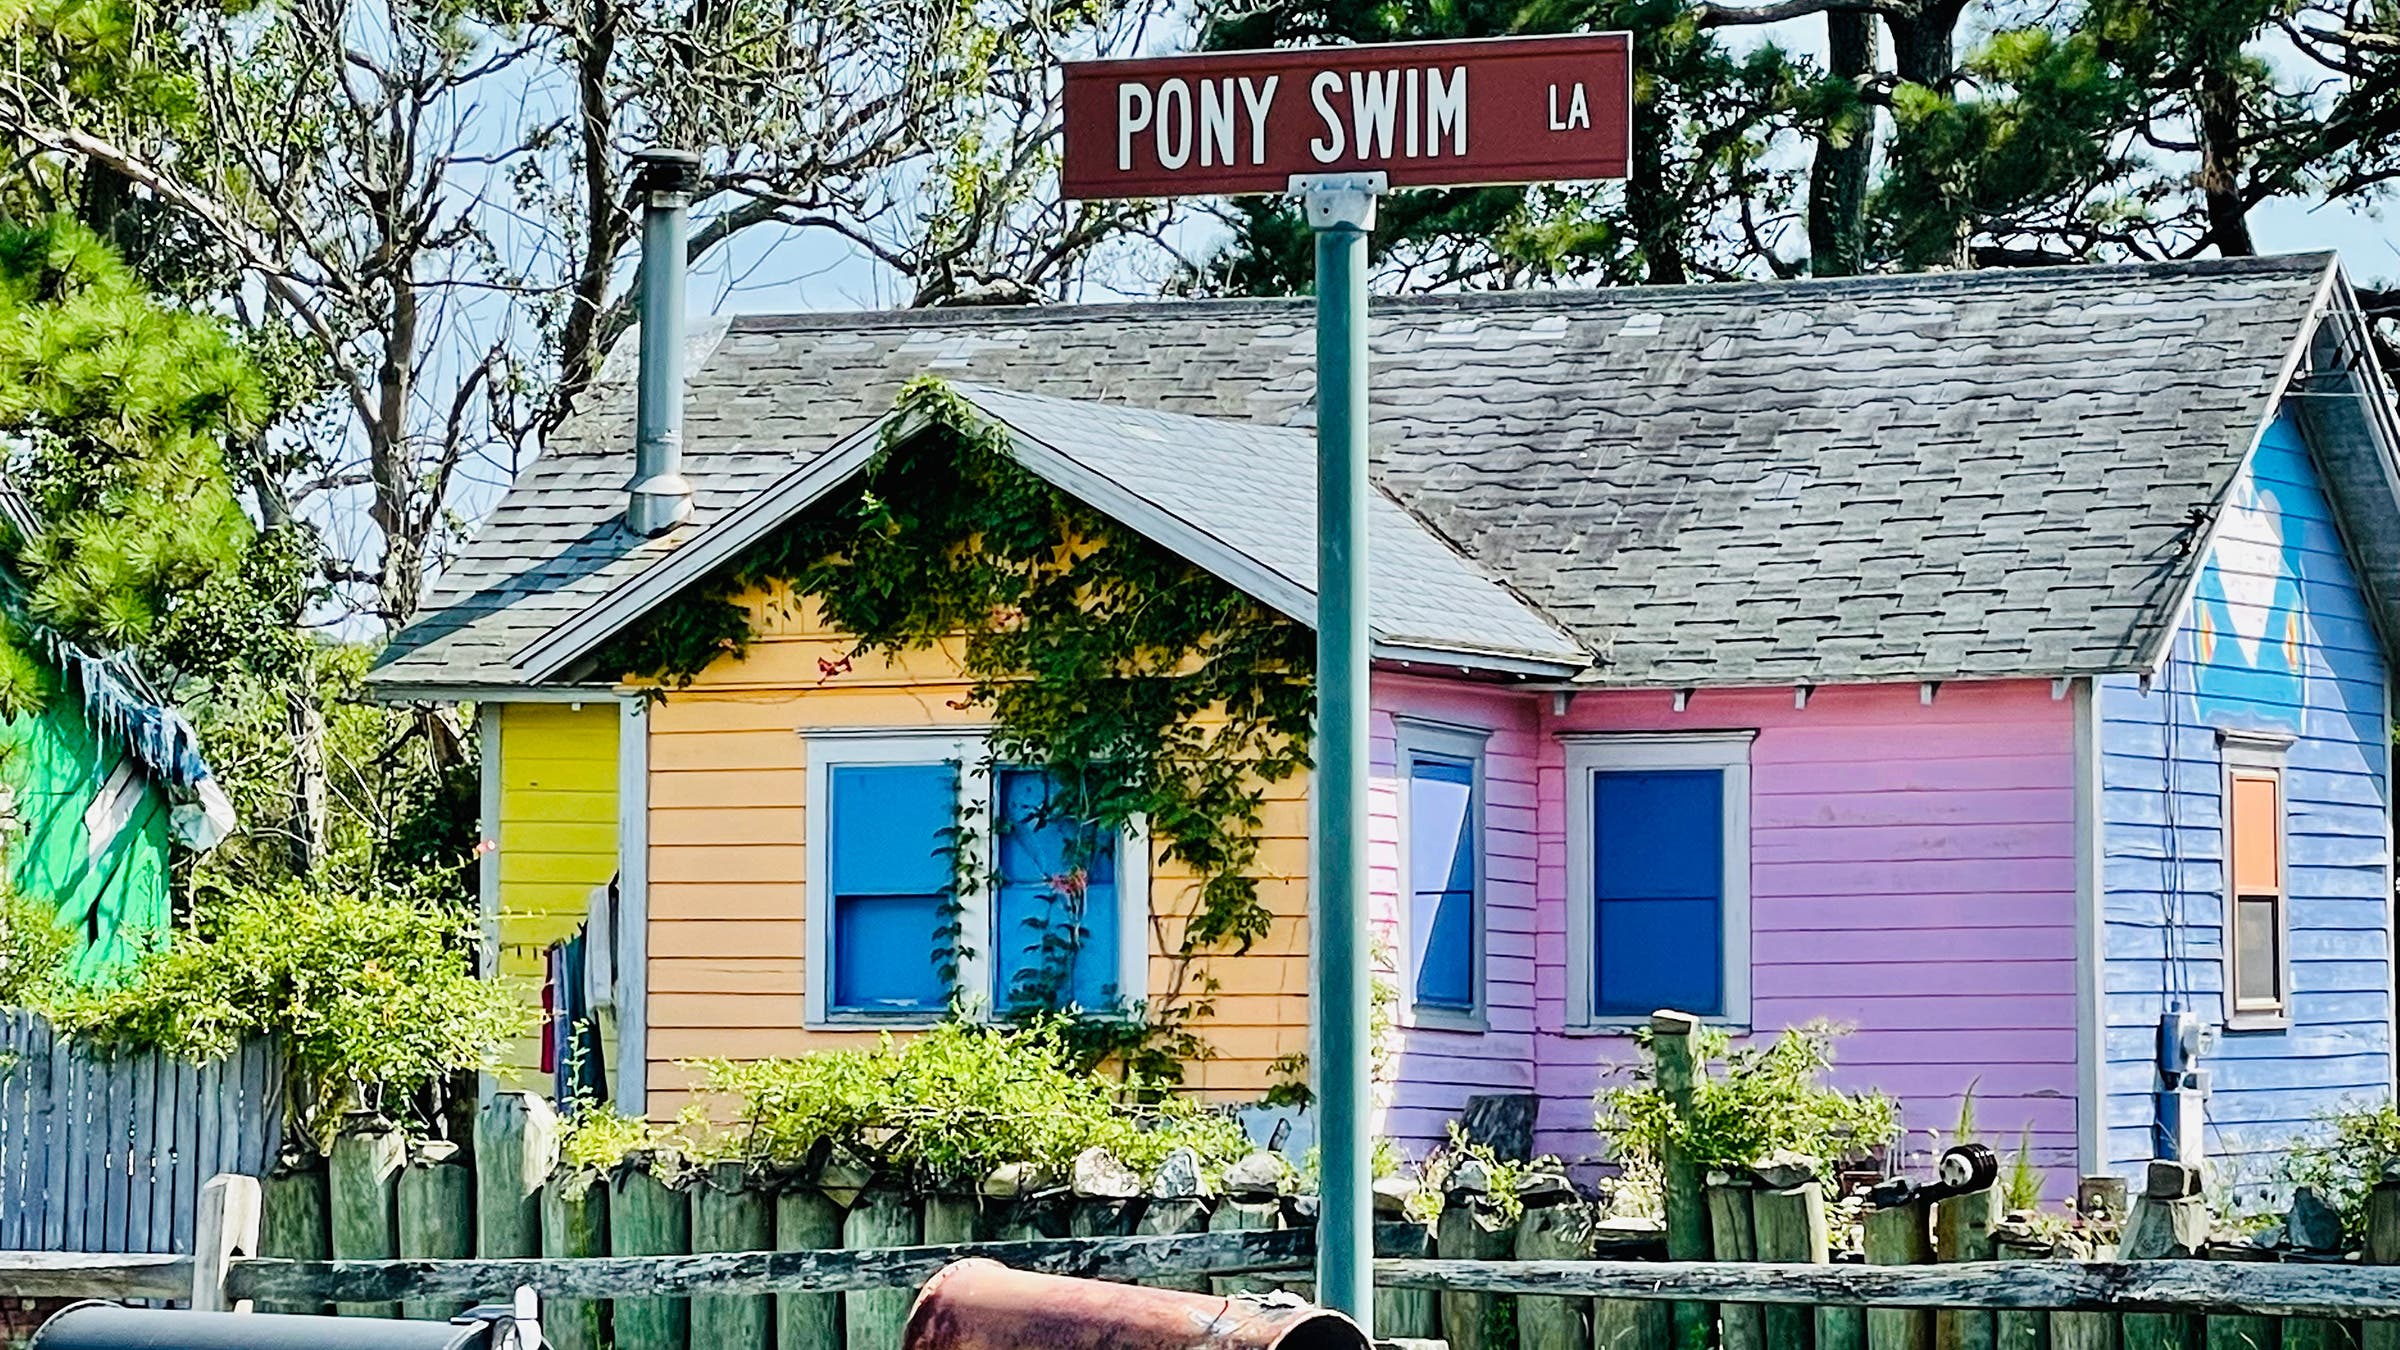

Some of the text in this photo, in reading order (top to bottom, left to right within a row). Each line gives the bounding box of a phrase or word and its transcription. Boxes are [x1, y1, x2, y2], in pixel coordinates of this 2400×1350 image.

[1118, 66, 1590, 171] PONY SWIM LA
